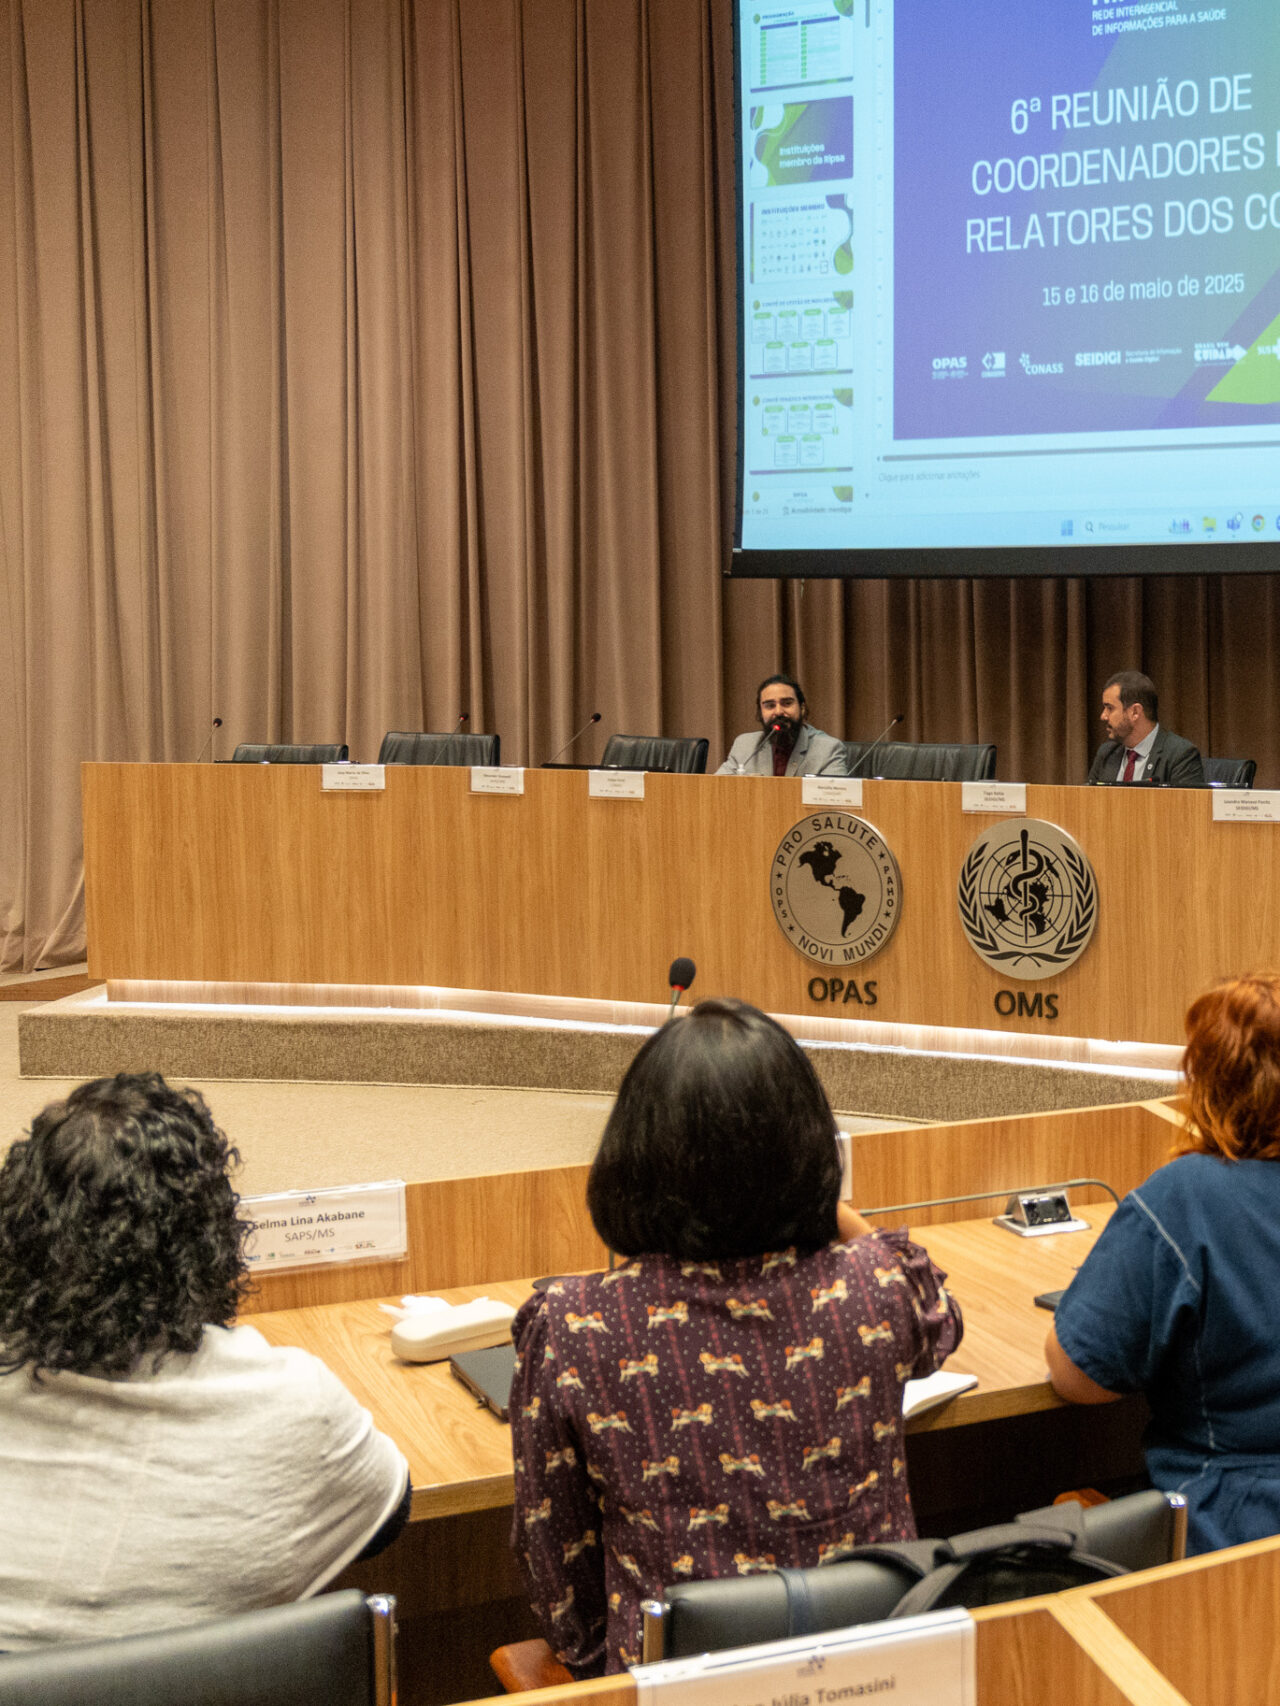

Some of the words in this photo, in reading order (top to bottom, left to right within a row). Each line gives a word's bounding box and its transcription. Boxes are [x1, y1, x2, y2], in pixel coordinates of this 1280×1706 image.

[1092, 9, 1114, 21] REDE
[1116, 1, 1178, 18] INTERAGENCIAL
[1092, 25, 1103, 36] DE
[1105, 17, 1164, 35] INFORMAÇÕES
[1165, 13, 1188, 27] PARA
[1189, 12, 1196, 23] A
[1197, 8, 1227, 23] SAÚDE
[1011, 97, 1041, 135] 6ª
[1051, 77, 1199, 130] REUNIÃO
[1210, 73, 1252, 114] DE
[971, 132, 1265, 196] COORDENADORES
[966, 203, 1154, 254] RELATORES
[1164, 196, 1234, 237] DOS
[1042, 286, 1060, 306] 15
[1065, 287, 1076, 304] e
[1080, 283, 1099, 304] 16
[1103, 280, 1125, 302] de
[1129, 277, 1173, 300] maio
[1177, 274, 1199, 296] de
[1204, 273, 1245, 295] 2025
[932, 357, 967, 370] OPAS
[1025, 363, 1064, 376] CONASS
[1075, 350, 1121, 367] SEIDIGI
[776, 830, 803, 867] PRO
[811, 816, 880, 850] SALUTE
[883, 865, 895, 908] PAHO
[776, 887, 788, 919] OPS
[798, 935, 834, 962] NOVI
[843, 922, 888, 962] MUNDI
[807, 977, 878, 1006] OPAS
[993, 990, 1060, 1020] OMS
[253, 1218, 287, 1231] Selma
[290, 1216, 313, 1227] Lina
[316, 1209, 365, 1223] Akabane
[284, 1228, 335, 1243] SAPS/MS
[815, 1673, 896, 1704] Tomasini
